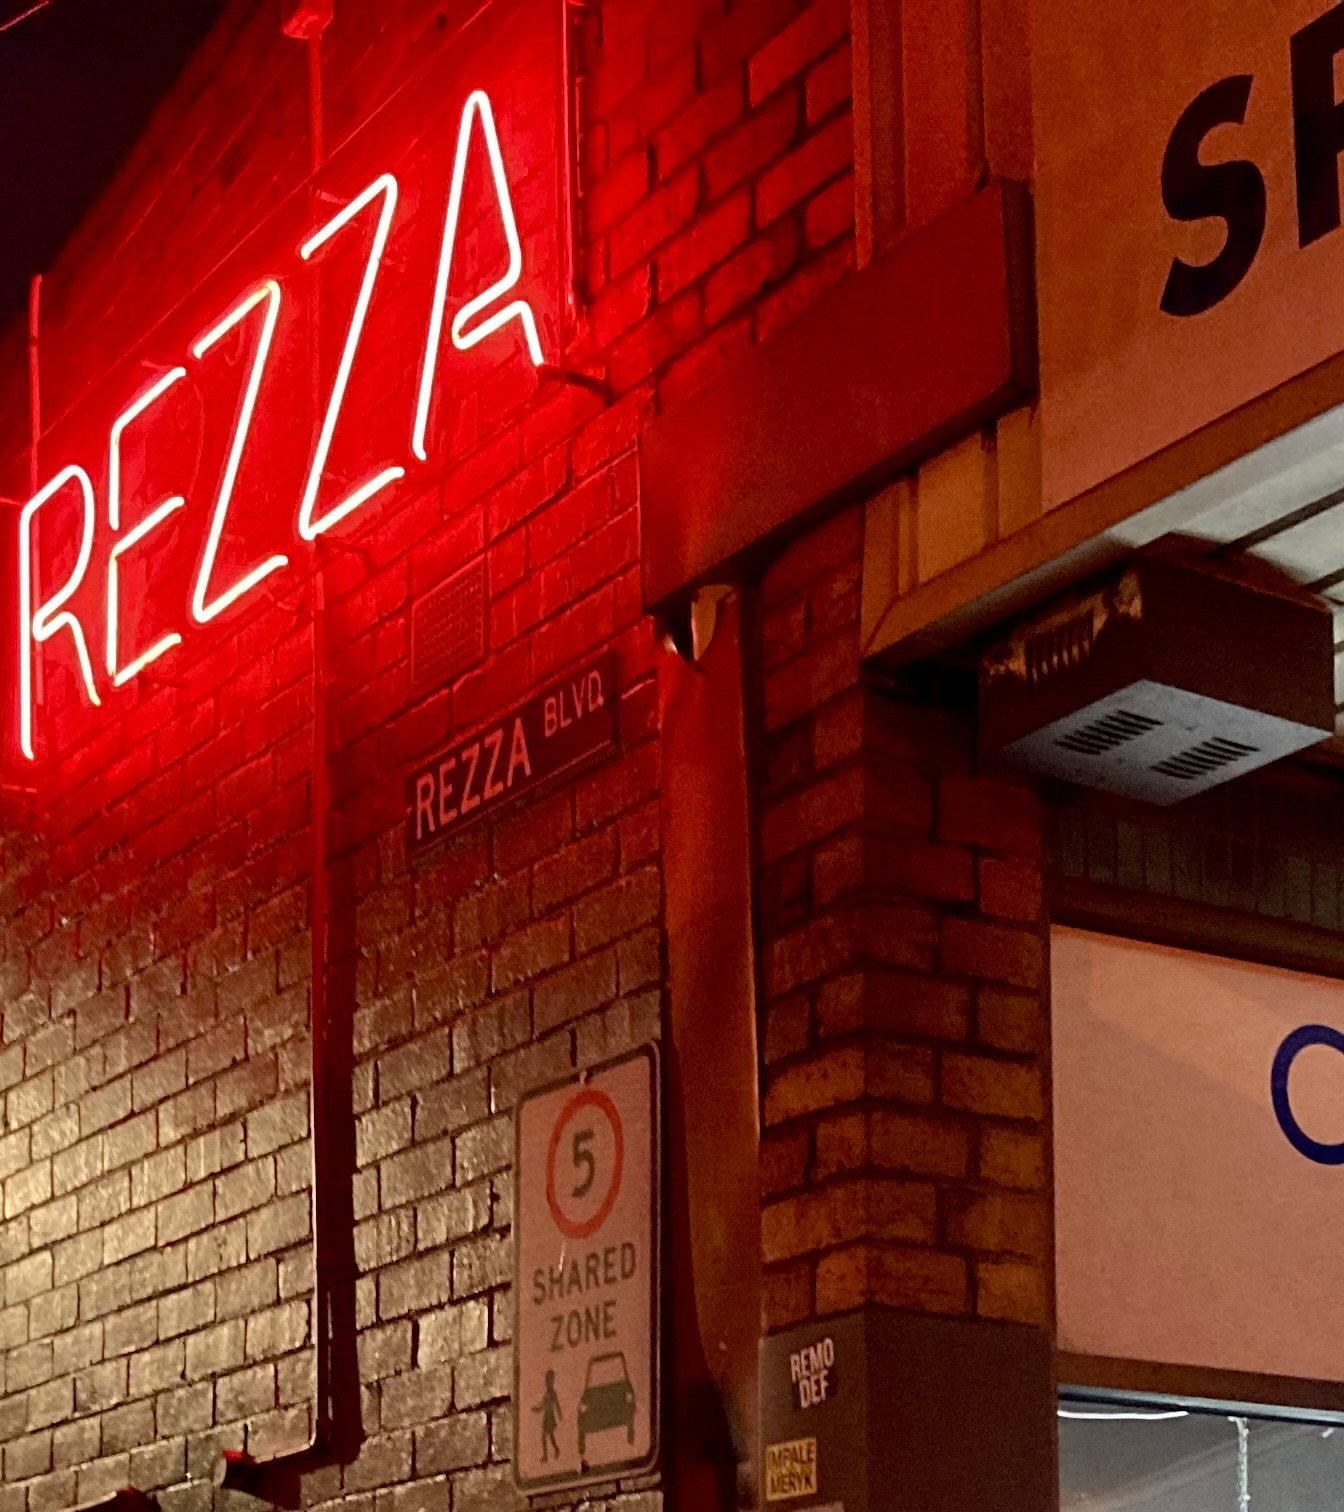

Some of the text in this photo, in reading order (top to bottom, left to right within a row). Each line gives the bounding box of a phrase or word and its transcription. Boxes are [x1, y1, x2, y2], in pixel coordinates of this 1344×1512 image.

[20, 90, 544, 760] REZZA
[416, 669, 605, 840] REZZA BLVD
[571, 1129, 596, 1198] 5
[532, 1242, 637, 1304] SHARED
[551, 1301, 617, 1352] ZONE
[790, 1337, 835, 1384] REMO
[799, 1369, 830, 1409] DEF
